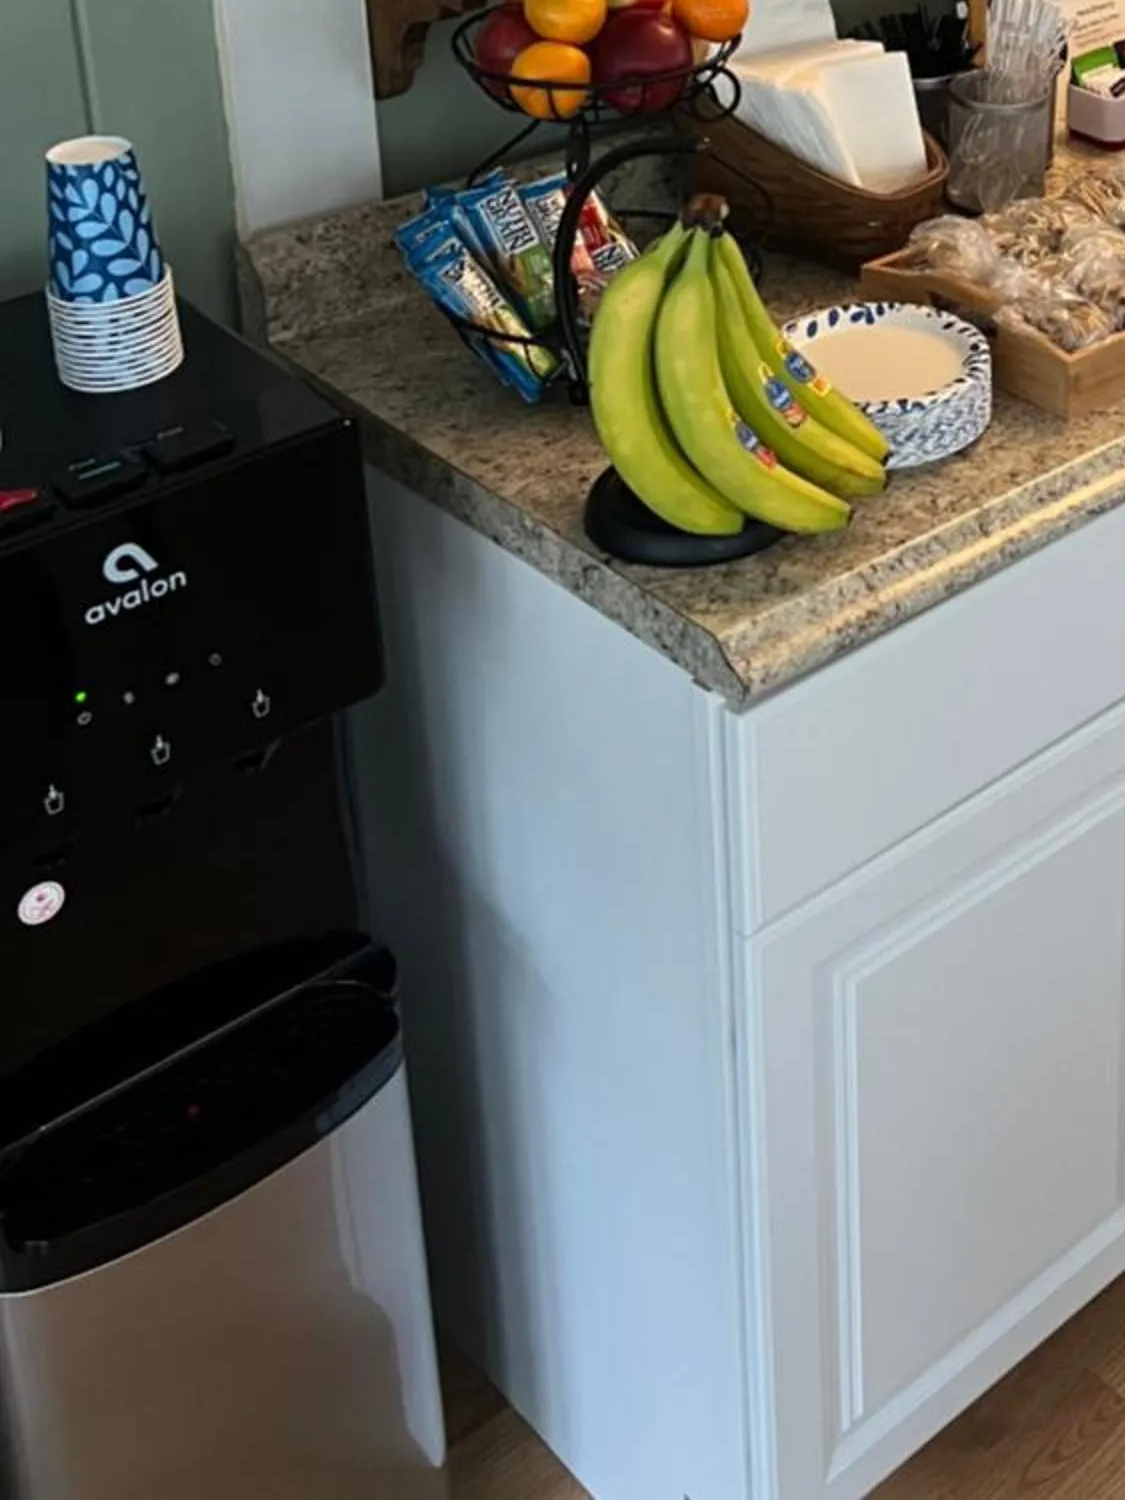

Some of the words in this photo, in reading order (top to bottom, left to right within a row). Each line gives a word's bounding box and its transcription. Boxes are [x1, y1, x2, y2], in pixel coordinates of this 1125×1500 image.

[487, 198, 524, 252] GRAIN
[500, 186, 537, 248] NUTRI
[85, 571, 187, 625] avalon
